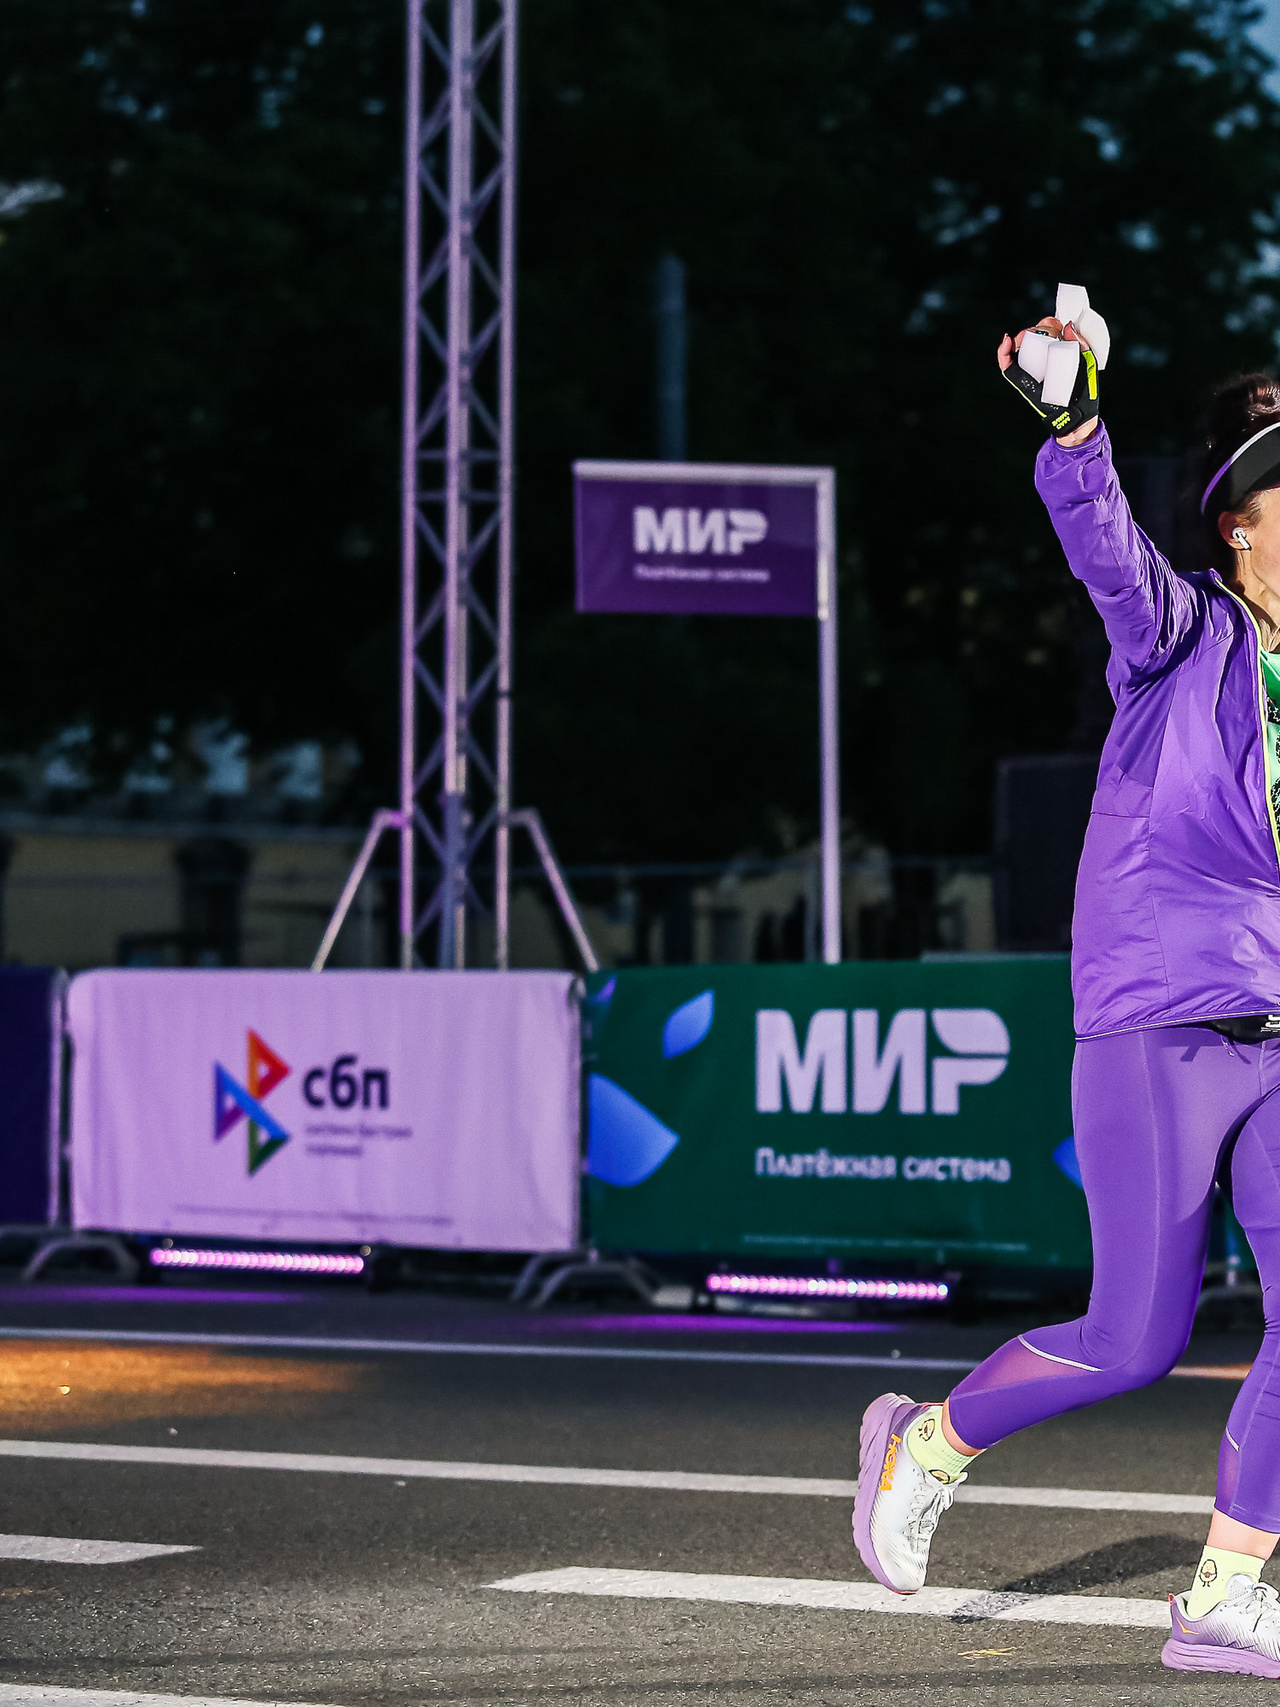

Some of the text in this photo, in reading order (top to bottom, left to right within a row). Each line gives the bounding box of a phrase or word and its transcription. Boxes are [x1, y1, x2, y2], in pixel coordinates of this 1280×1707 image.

[633, 505, 768, 556] МИР
[303, 1055, 390, 1111] сбп
[755, 1008, 1011, 1115] МИР
[755, 1147, 1012, 1184] Платёжная система
[879, 1433, 902, 1490] HOKA
